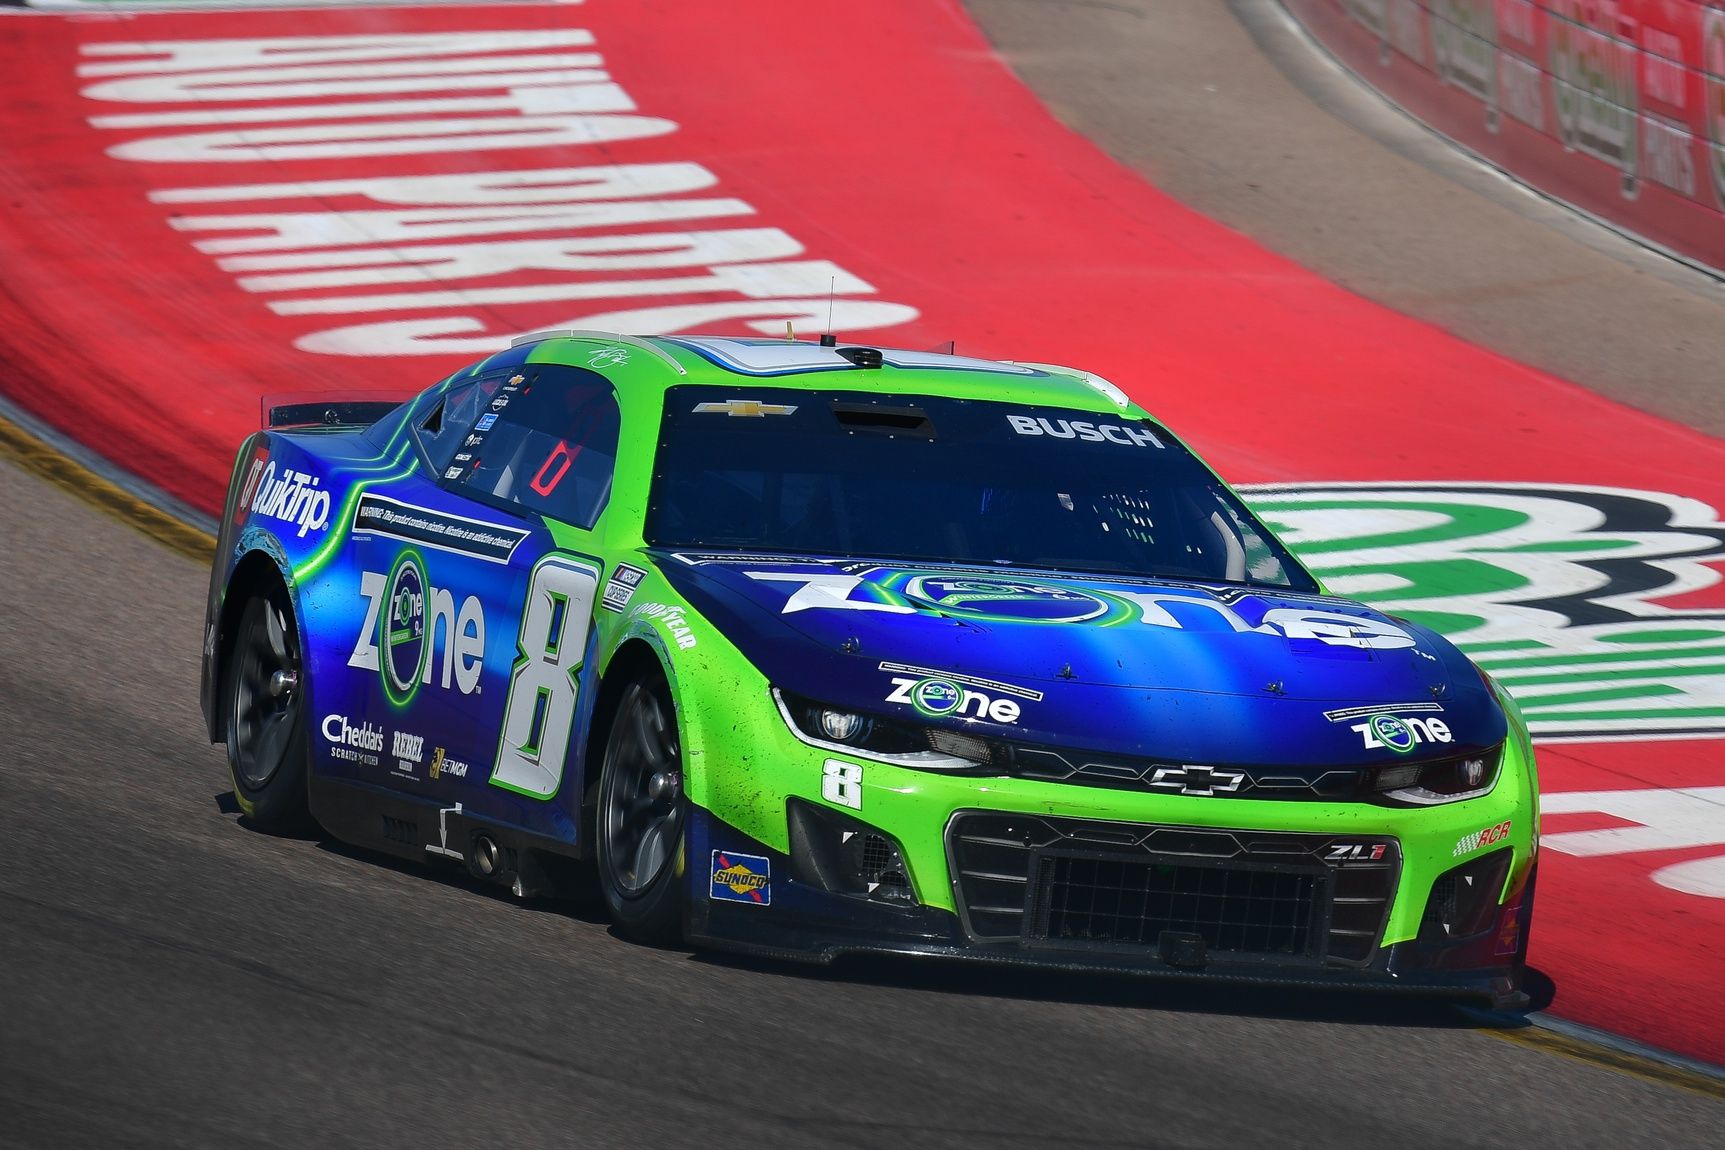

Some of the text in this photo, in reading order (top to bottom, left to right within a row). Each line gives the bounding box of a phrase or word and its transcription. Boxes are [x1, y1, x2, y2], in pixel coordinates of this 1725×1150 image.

[76, 27, 682, 164] AUTO
[146, 160, 921, 357] PARTS
[1006, 415, 1166, 449] BUSCH
[251, 460, 331, 538] QuikTrip
[627, 602, 697, 651] GOODYEAR
[489, 551, 605, 801] 8
[321, 714, 384, 752] Cheddar's
[391, 730, 424, 763] REBEL
[440, 758, 469, 777] BETMGM
[821, 758, 864, 811] 8
[1323, 844, 1387, 860] ZL1
[1475, 820, 1512, 849] RCR
[714, 869, 768, 889] SUNOCO
